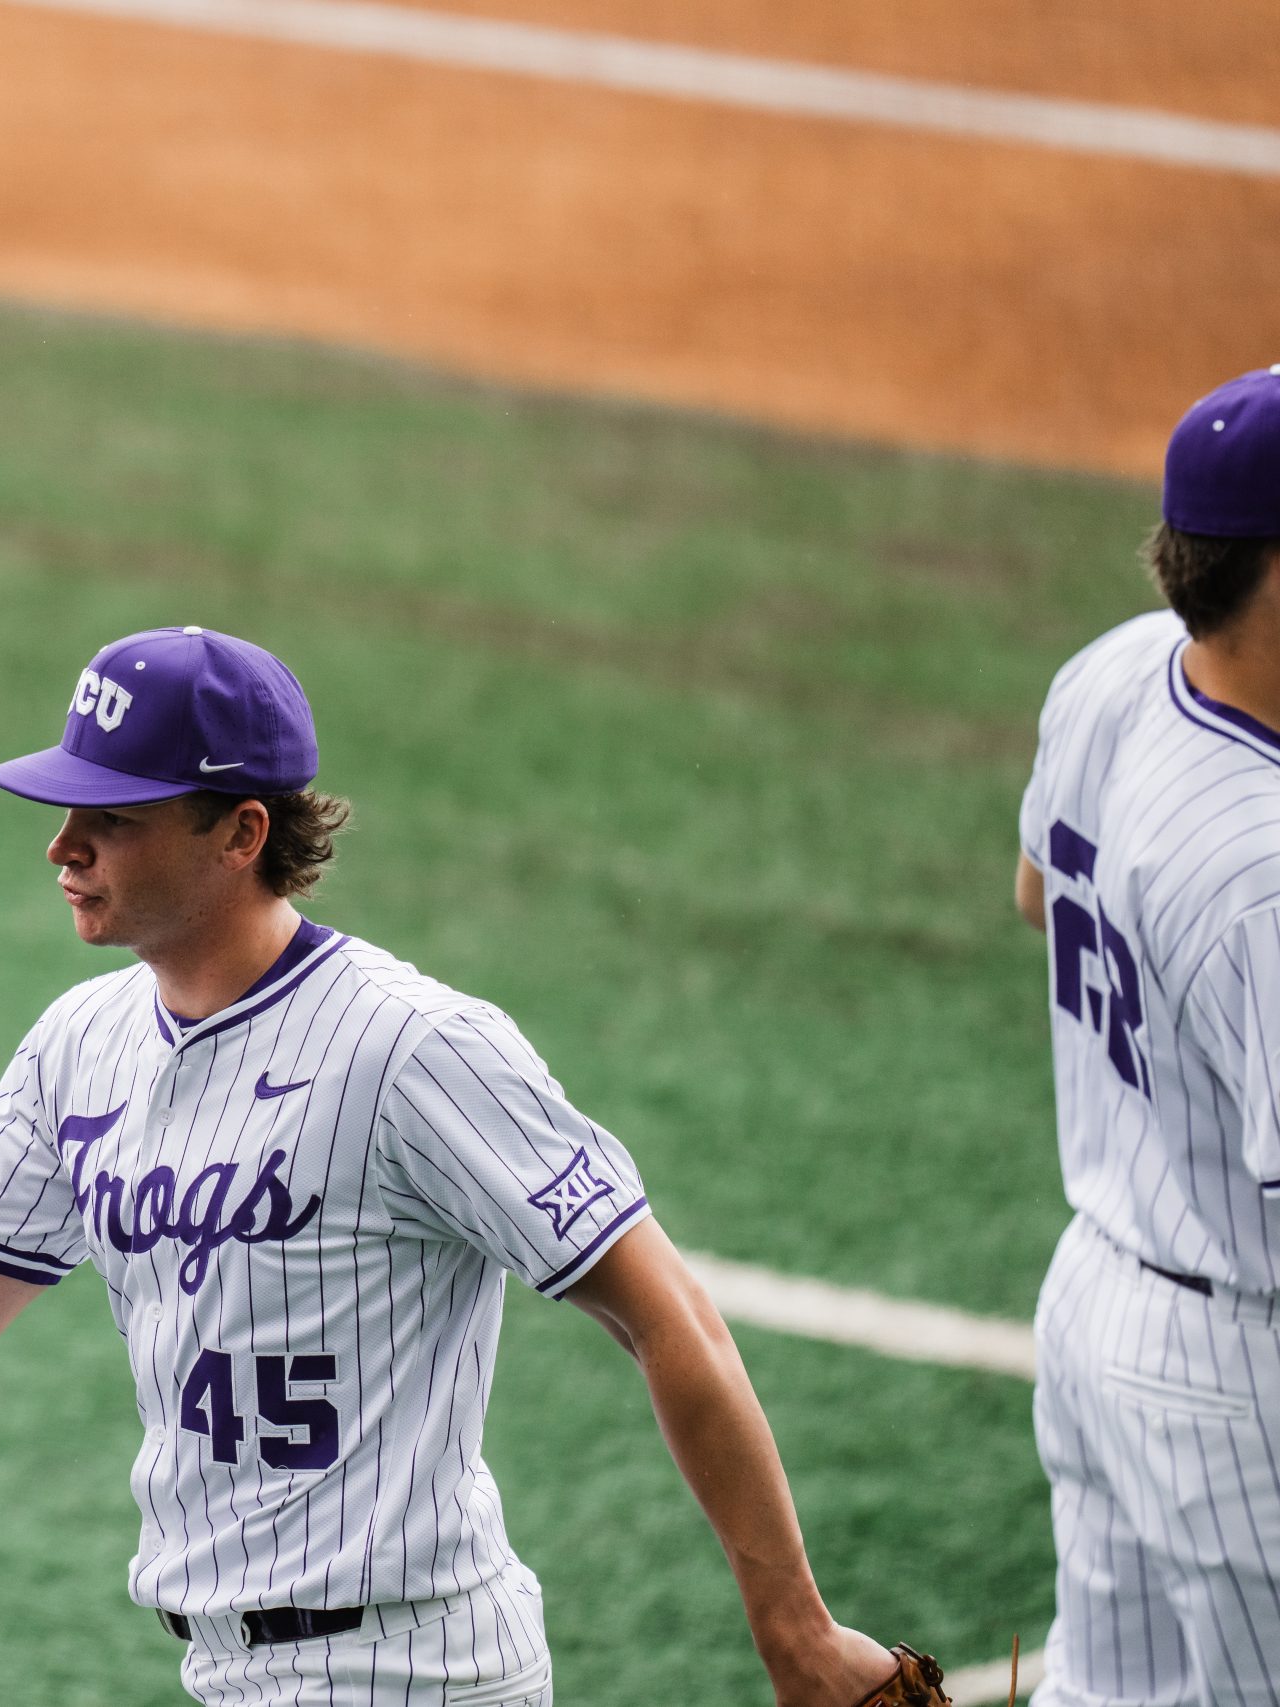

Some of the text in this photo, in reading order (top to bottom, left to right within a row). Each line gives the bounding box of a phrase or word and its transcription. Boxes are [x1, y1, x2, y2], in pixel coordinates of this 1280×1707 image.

[66, 667, 134, 733] CU
[57, 1099, 321, 1297] Frogs
[179, 1347, 343, 1475] 45
